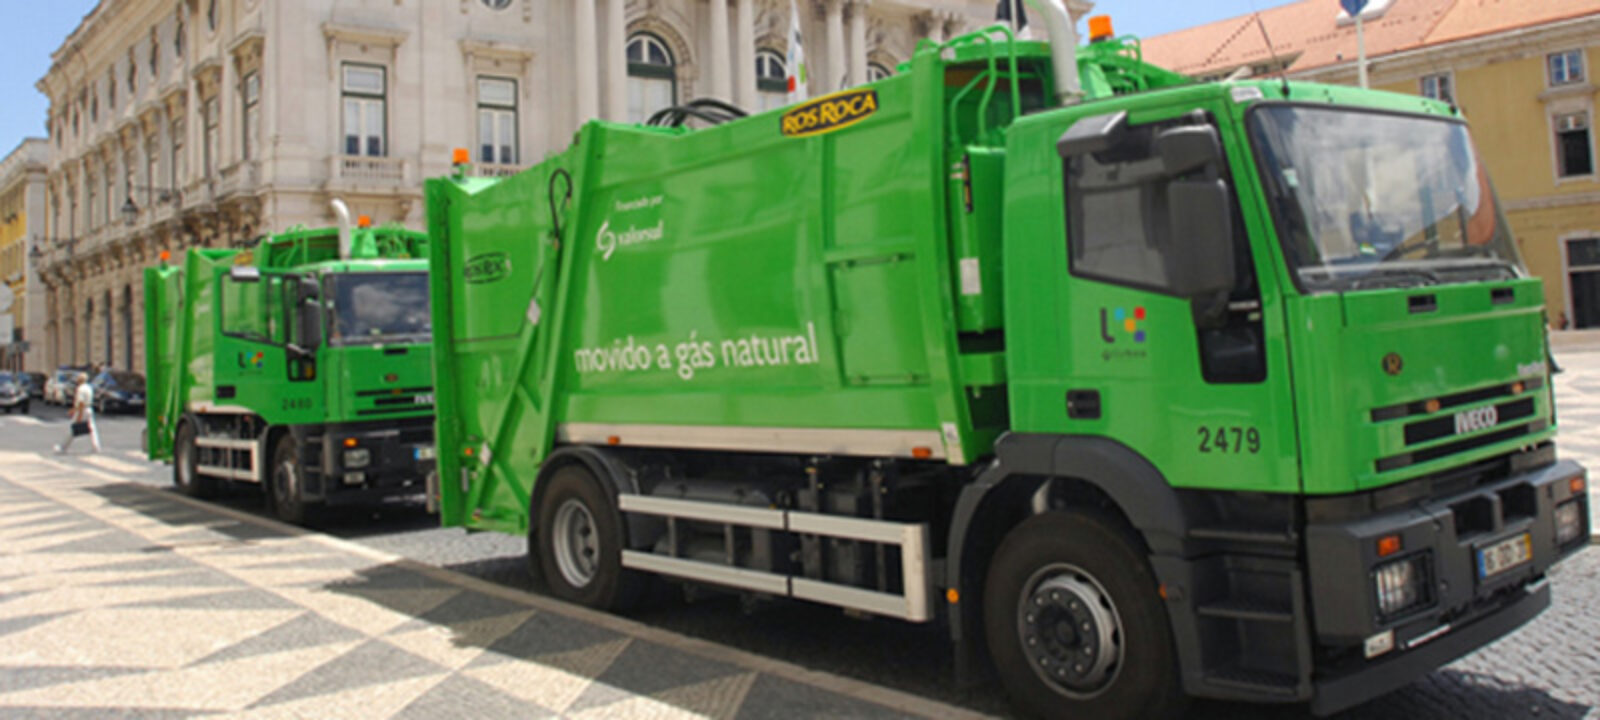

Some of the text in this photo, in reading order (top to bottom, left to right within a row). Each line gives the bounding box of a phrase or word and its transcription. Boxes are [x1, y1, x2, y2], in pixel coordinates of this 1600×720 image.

[783, 93, 875, 134] ROS ROCA
[573, 321, 819, 380] movido a gás natural
[1454, 404, 1498, 435] IVECO
[1198, 426, 1261, 454] 2479
